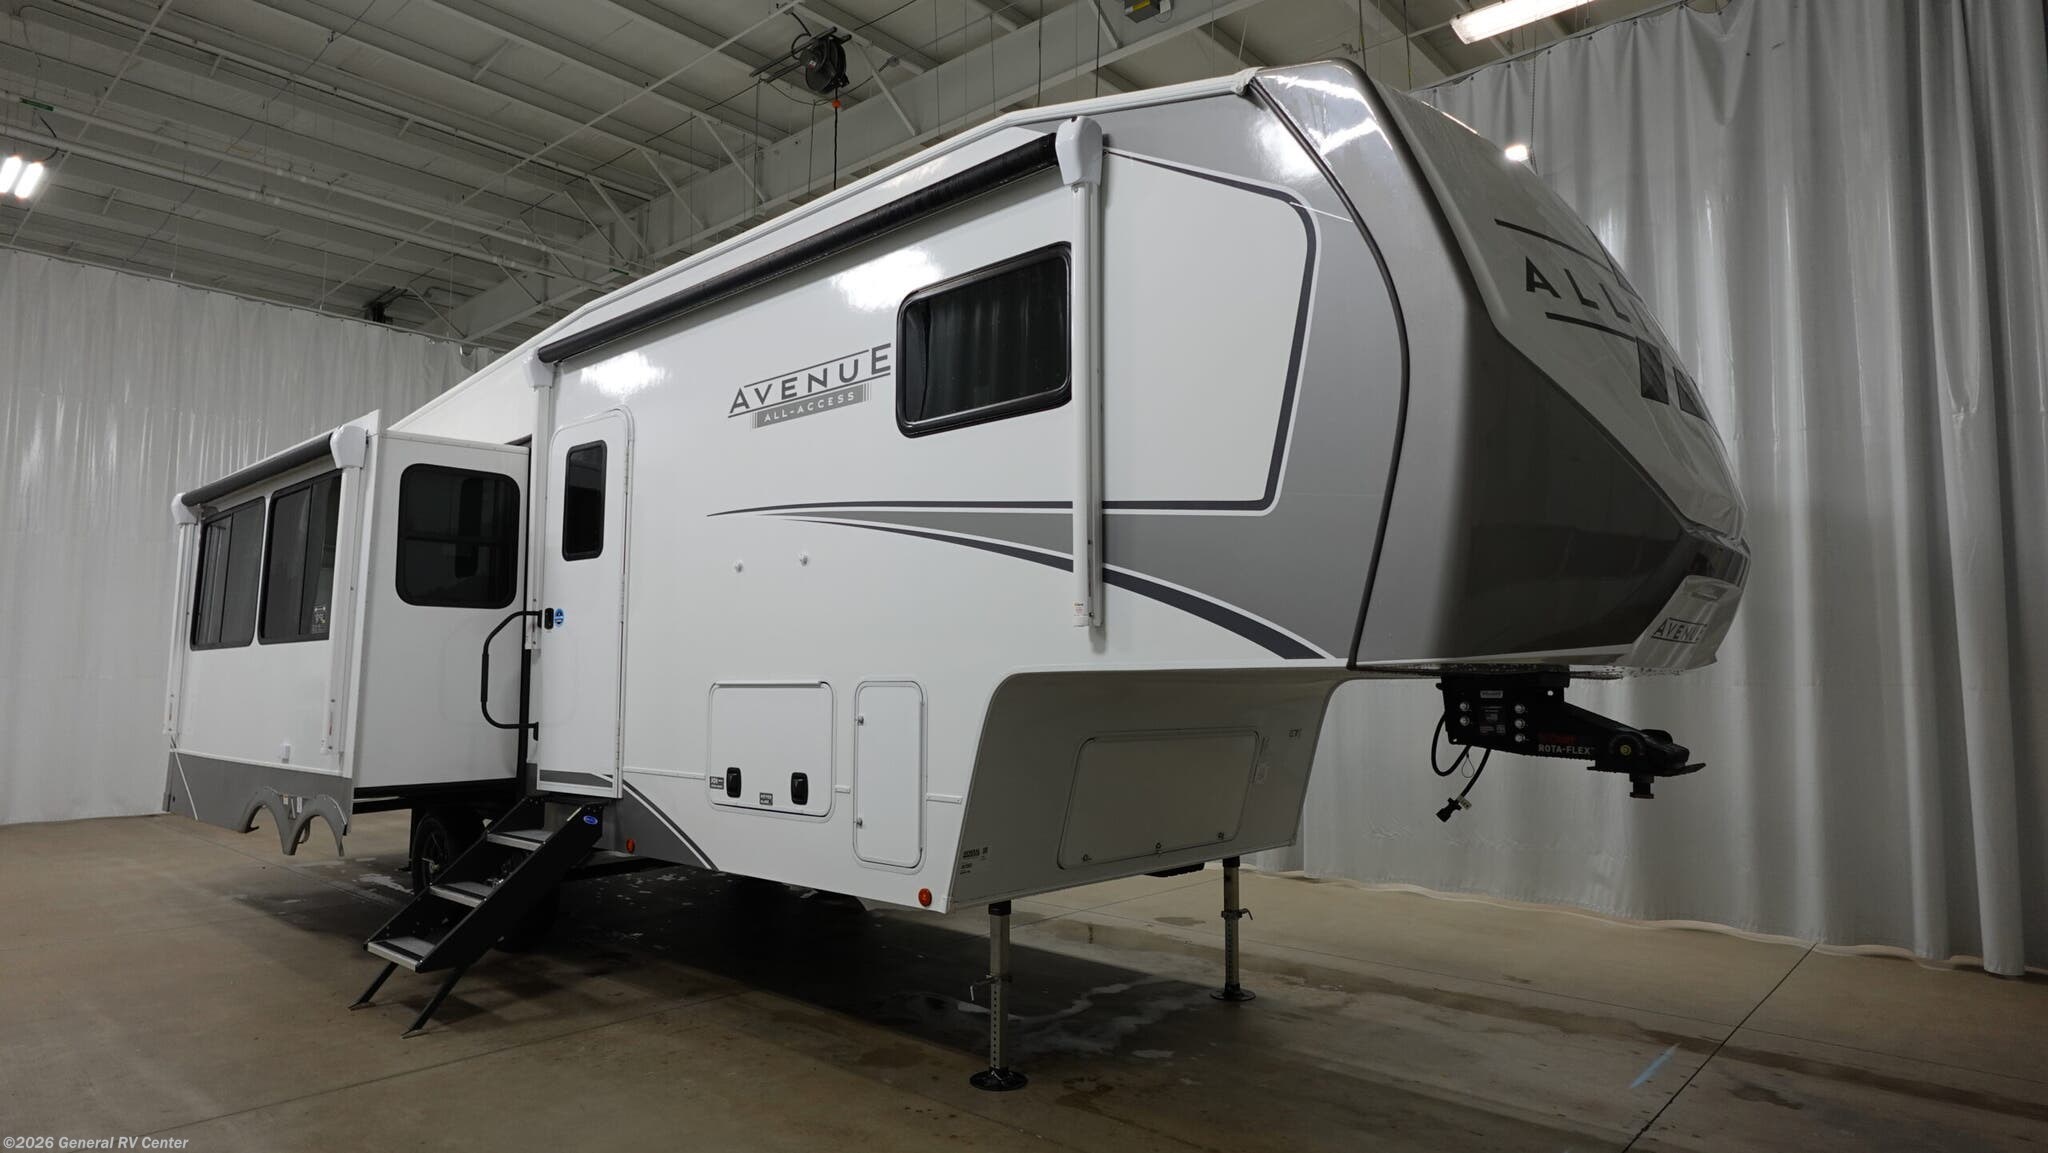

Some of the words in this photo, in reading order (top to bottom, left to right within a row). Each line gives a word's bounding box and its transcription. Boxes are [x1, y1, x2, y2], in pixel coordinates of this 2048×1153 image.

[729, 342, 892, 414] AVENUE
[763, 391, 855, 423] ALL-ACCESS
[1538, 743, 1591, 756] ROTA-FLEX
